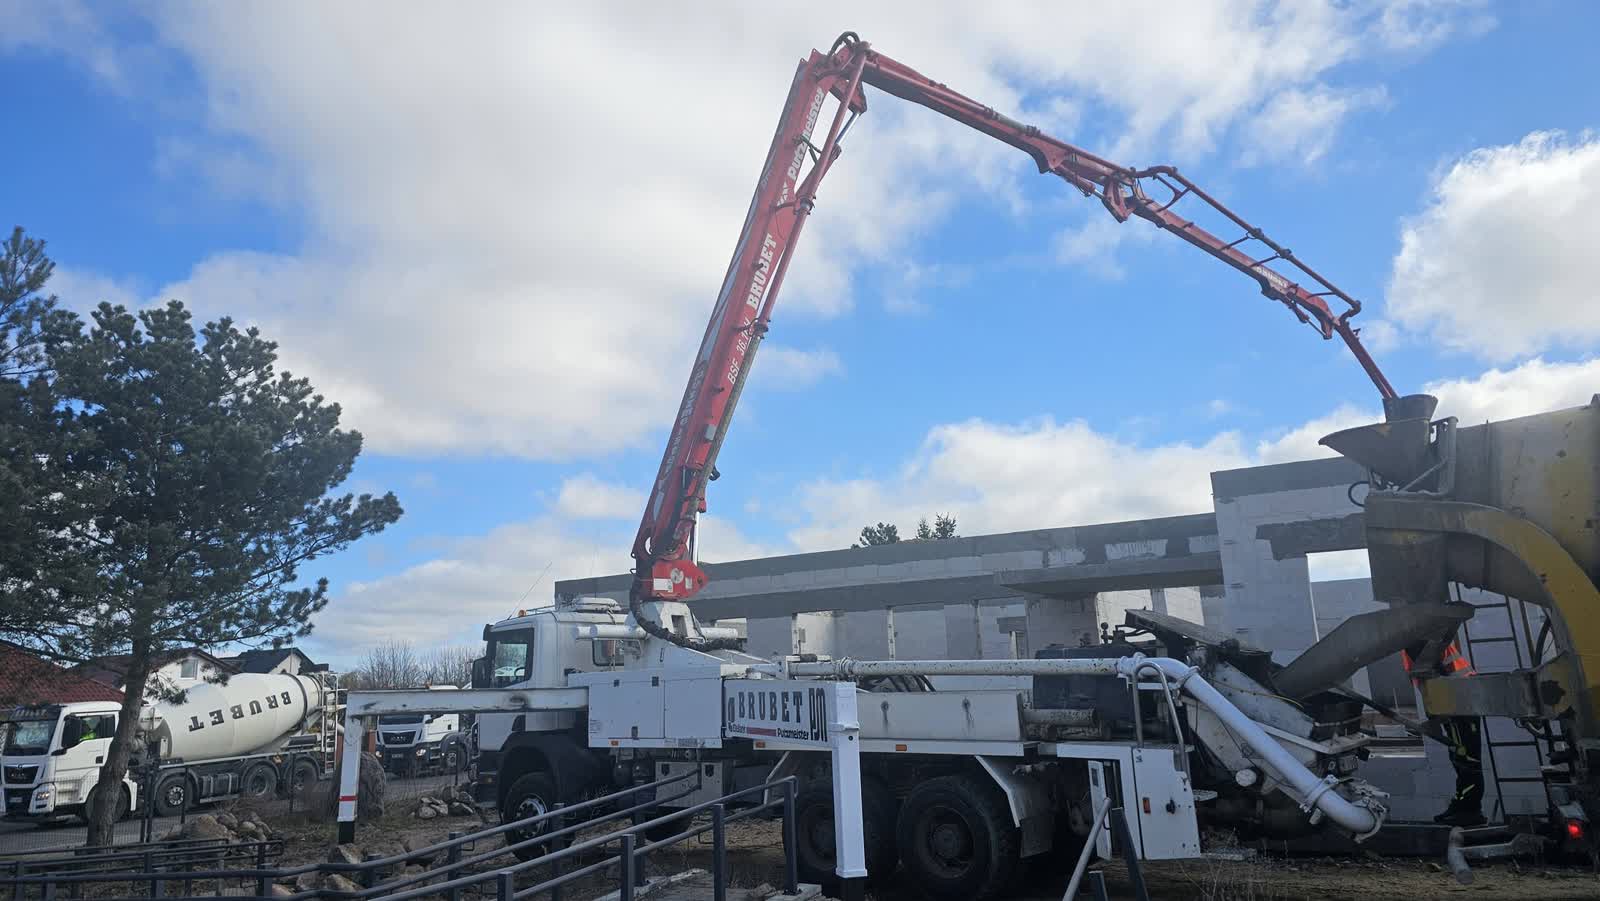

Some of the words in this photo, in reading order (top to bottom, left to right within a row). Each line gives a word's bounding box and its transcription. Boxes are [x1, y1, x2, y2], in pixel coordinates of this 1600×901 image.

[746, 232, 778, 310] BRUBET
[727, 358, 741, 385] BSF
[188, 691, 292, 732] BRUBET
[738, 691, 803, 723] BRUBET
